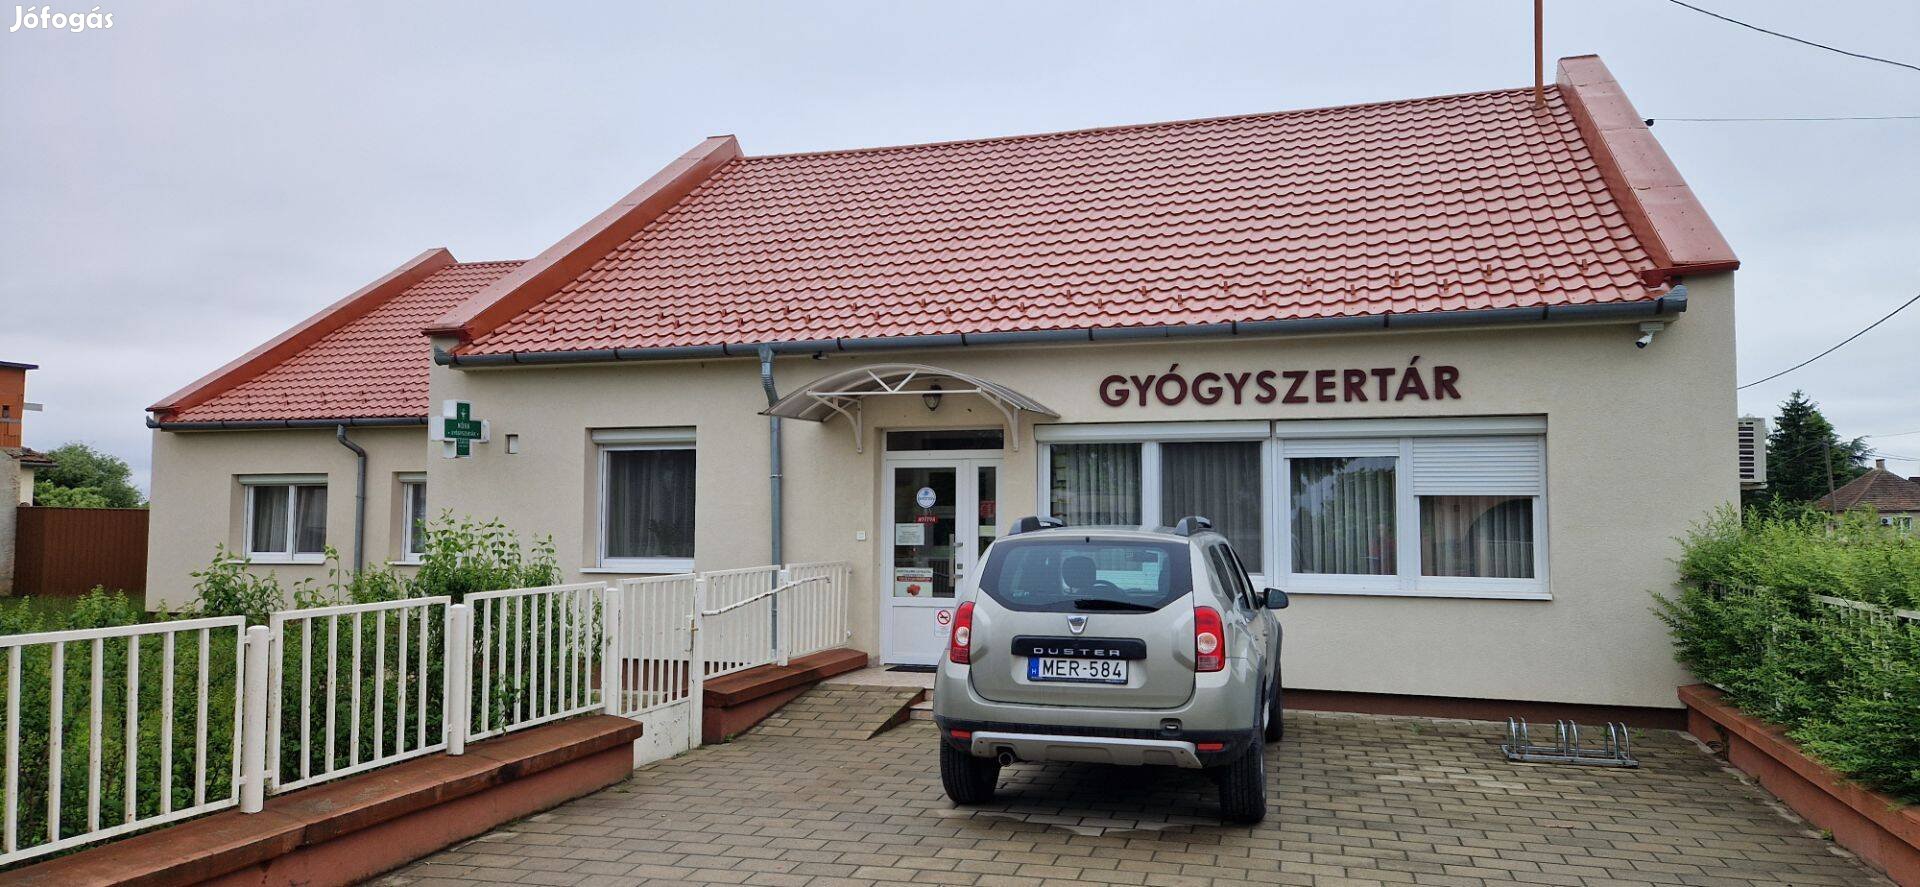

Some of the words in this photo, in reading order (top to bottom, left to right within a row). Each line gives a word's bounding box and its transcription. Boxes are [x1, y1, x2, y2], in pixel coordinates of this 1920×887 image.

[1099, 355, 1462, 407] GYÓGYSZERTÁR
[1033, 647, 1120, 656] DUSTER
[1043, 659, 1122, 678] MER-584
